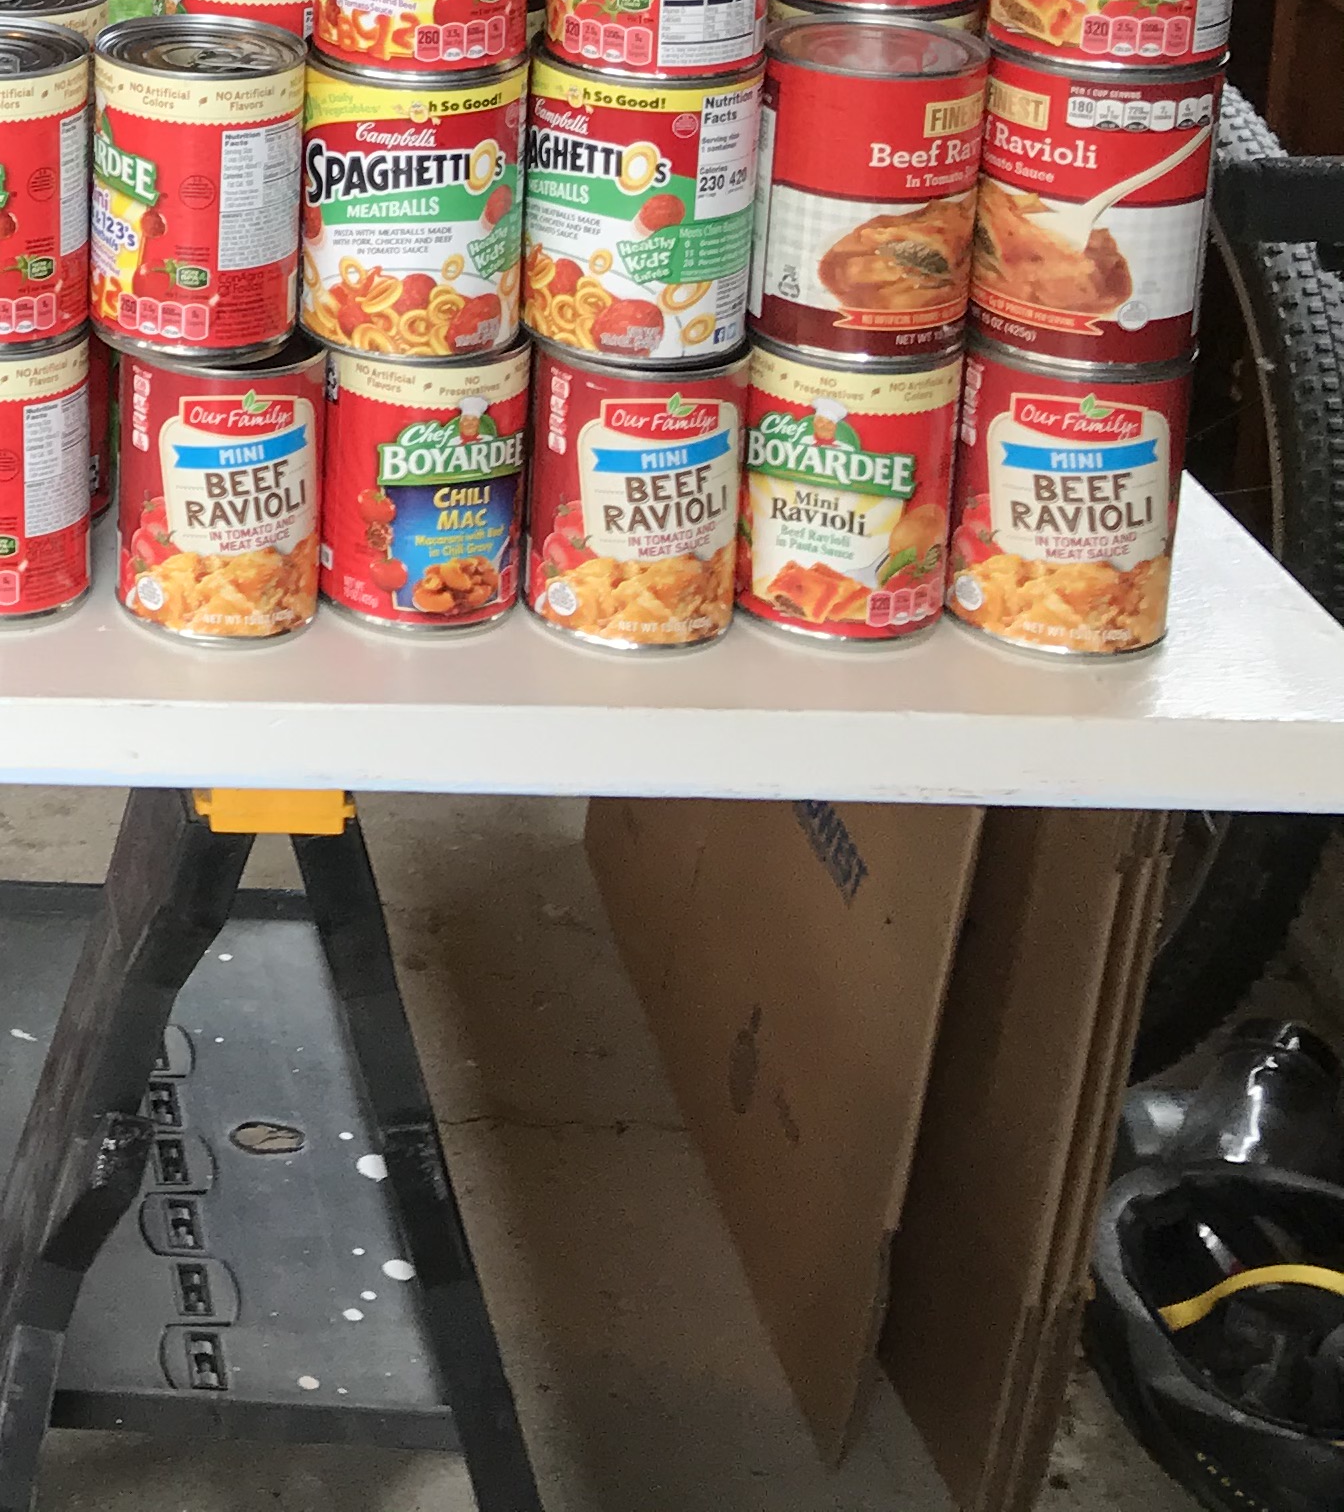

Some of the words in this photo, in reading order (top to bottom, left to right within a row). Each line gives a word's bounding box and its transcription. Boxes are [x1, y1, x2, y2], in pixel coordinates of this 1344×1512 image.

[441, 101, 458, 111] So
[462, 93, 502, 110] Good!
[355, 121, 437, 149] Campbell's
[995, 125, 1099, 170] Ravioli
[869, 142, 942, 168] Beef
[700, 176, 724, 192] 230
[728, 168, 747, 186] 420
[906, 174, 921, 188] In
[925, 172, 962, 187] Tomato
[346, 197, 440, 218] MEATBALLS
[378, 228, 425, 236] MEATBALLS
[428, 226, 452, 234] MADE
[189, 404, 224, 426] Our
[229, 405, 290, 434] Family
[611, 408, 646, 429] Our
[650, 407, 716, 435] Family
[760, 414, 807, 442] Chef
[1020, 404, 1060, 425] Our
[1062, 411, 1138, 441] Family
[401, 422, 454, 448] Chef
[219, 448, 264, 466] MINI
[641, 451, 688, 468] MINI
[749, 430, 912, 492] BOYARDEE
[1051, 452, 1103, 469] MINI
[205, 459, 290, 498] BEEF
[625, 464, 712, 504] BEEF
[1032, 472, 1132, 503] BEEF
[185, 479, 307, 527] RAVIOLI
[433, 486, 491, 508] CHILI
[795, 490, 839, 511] Mini
[437, 509, 488, 531] MAC
[603, 488, 727, 534] RAVIOLI
[770, 496, 871, 538] Ravioli
[1010, 496, 1152, 534] RAVIOLI
[209, 529, 221, 541] IN
[223, 522, 271, 541] TOMATO
[275, 515, 296, 533] AND
[219, 540, 250, 552] MEAT
[253, 530, 291, 548] SAUCE
